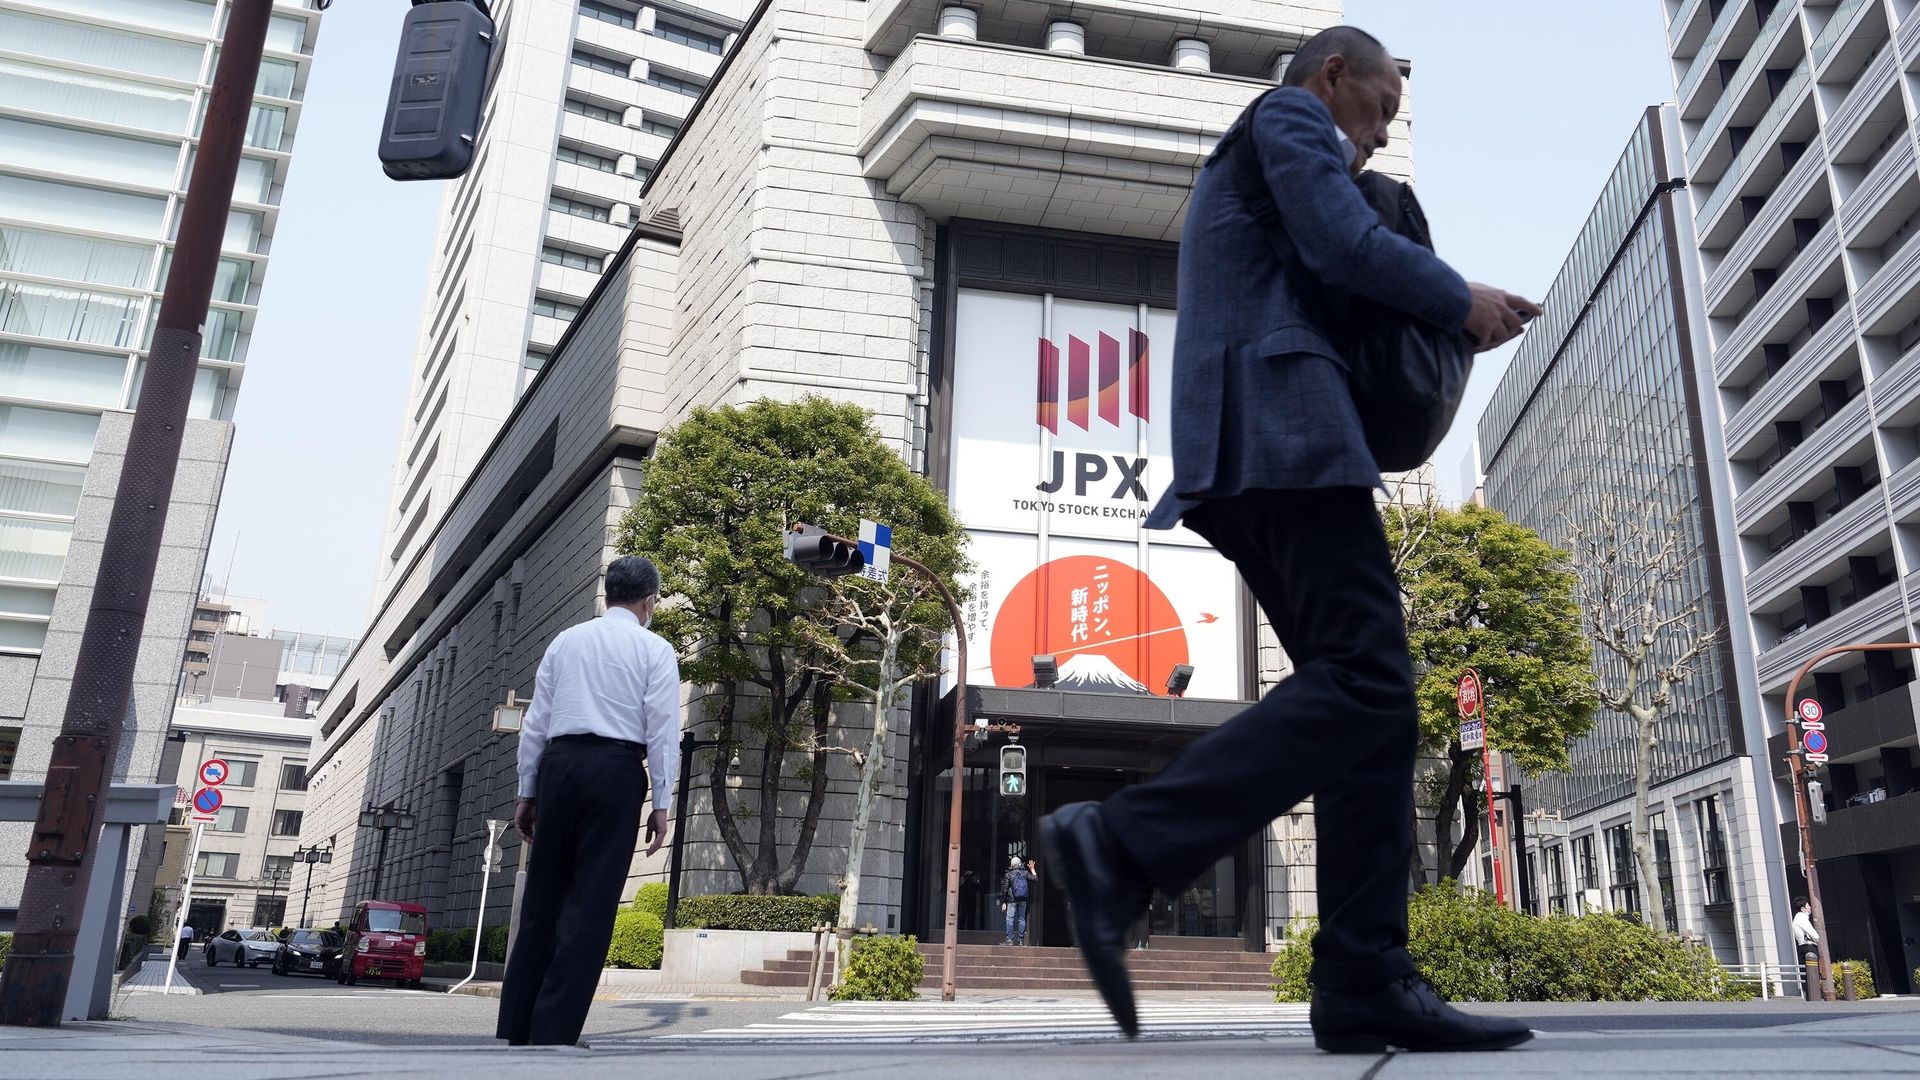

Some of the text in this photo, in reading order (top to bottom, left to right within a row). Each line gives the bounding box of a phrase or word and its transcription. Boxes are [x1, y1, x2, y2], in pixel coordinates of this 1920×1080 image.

[1036, 450, 1149, 502] JPX
[1013, 500, 1055, 513] TOKYO
[1058, 503, 1099, 517] STOCK
[980, 569, 990, 631] 余裕を持って、
[1071, 587, 1089, 642] 新時代
[1093, 564, 1112, 637] ニッポン、
[1805, 705, 1817, 716] 30
